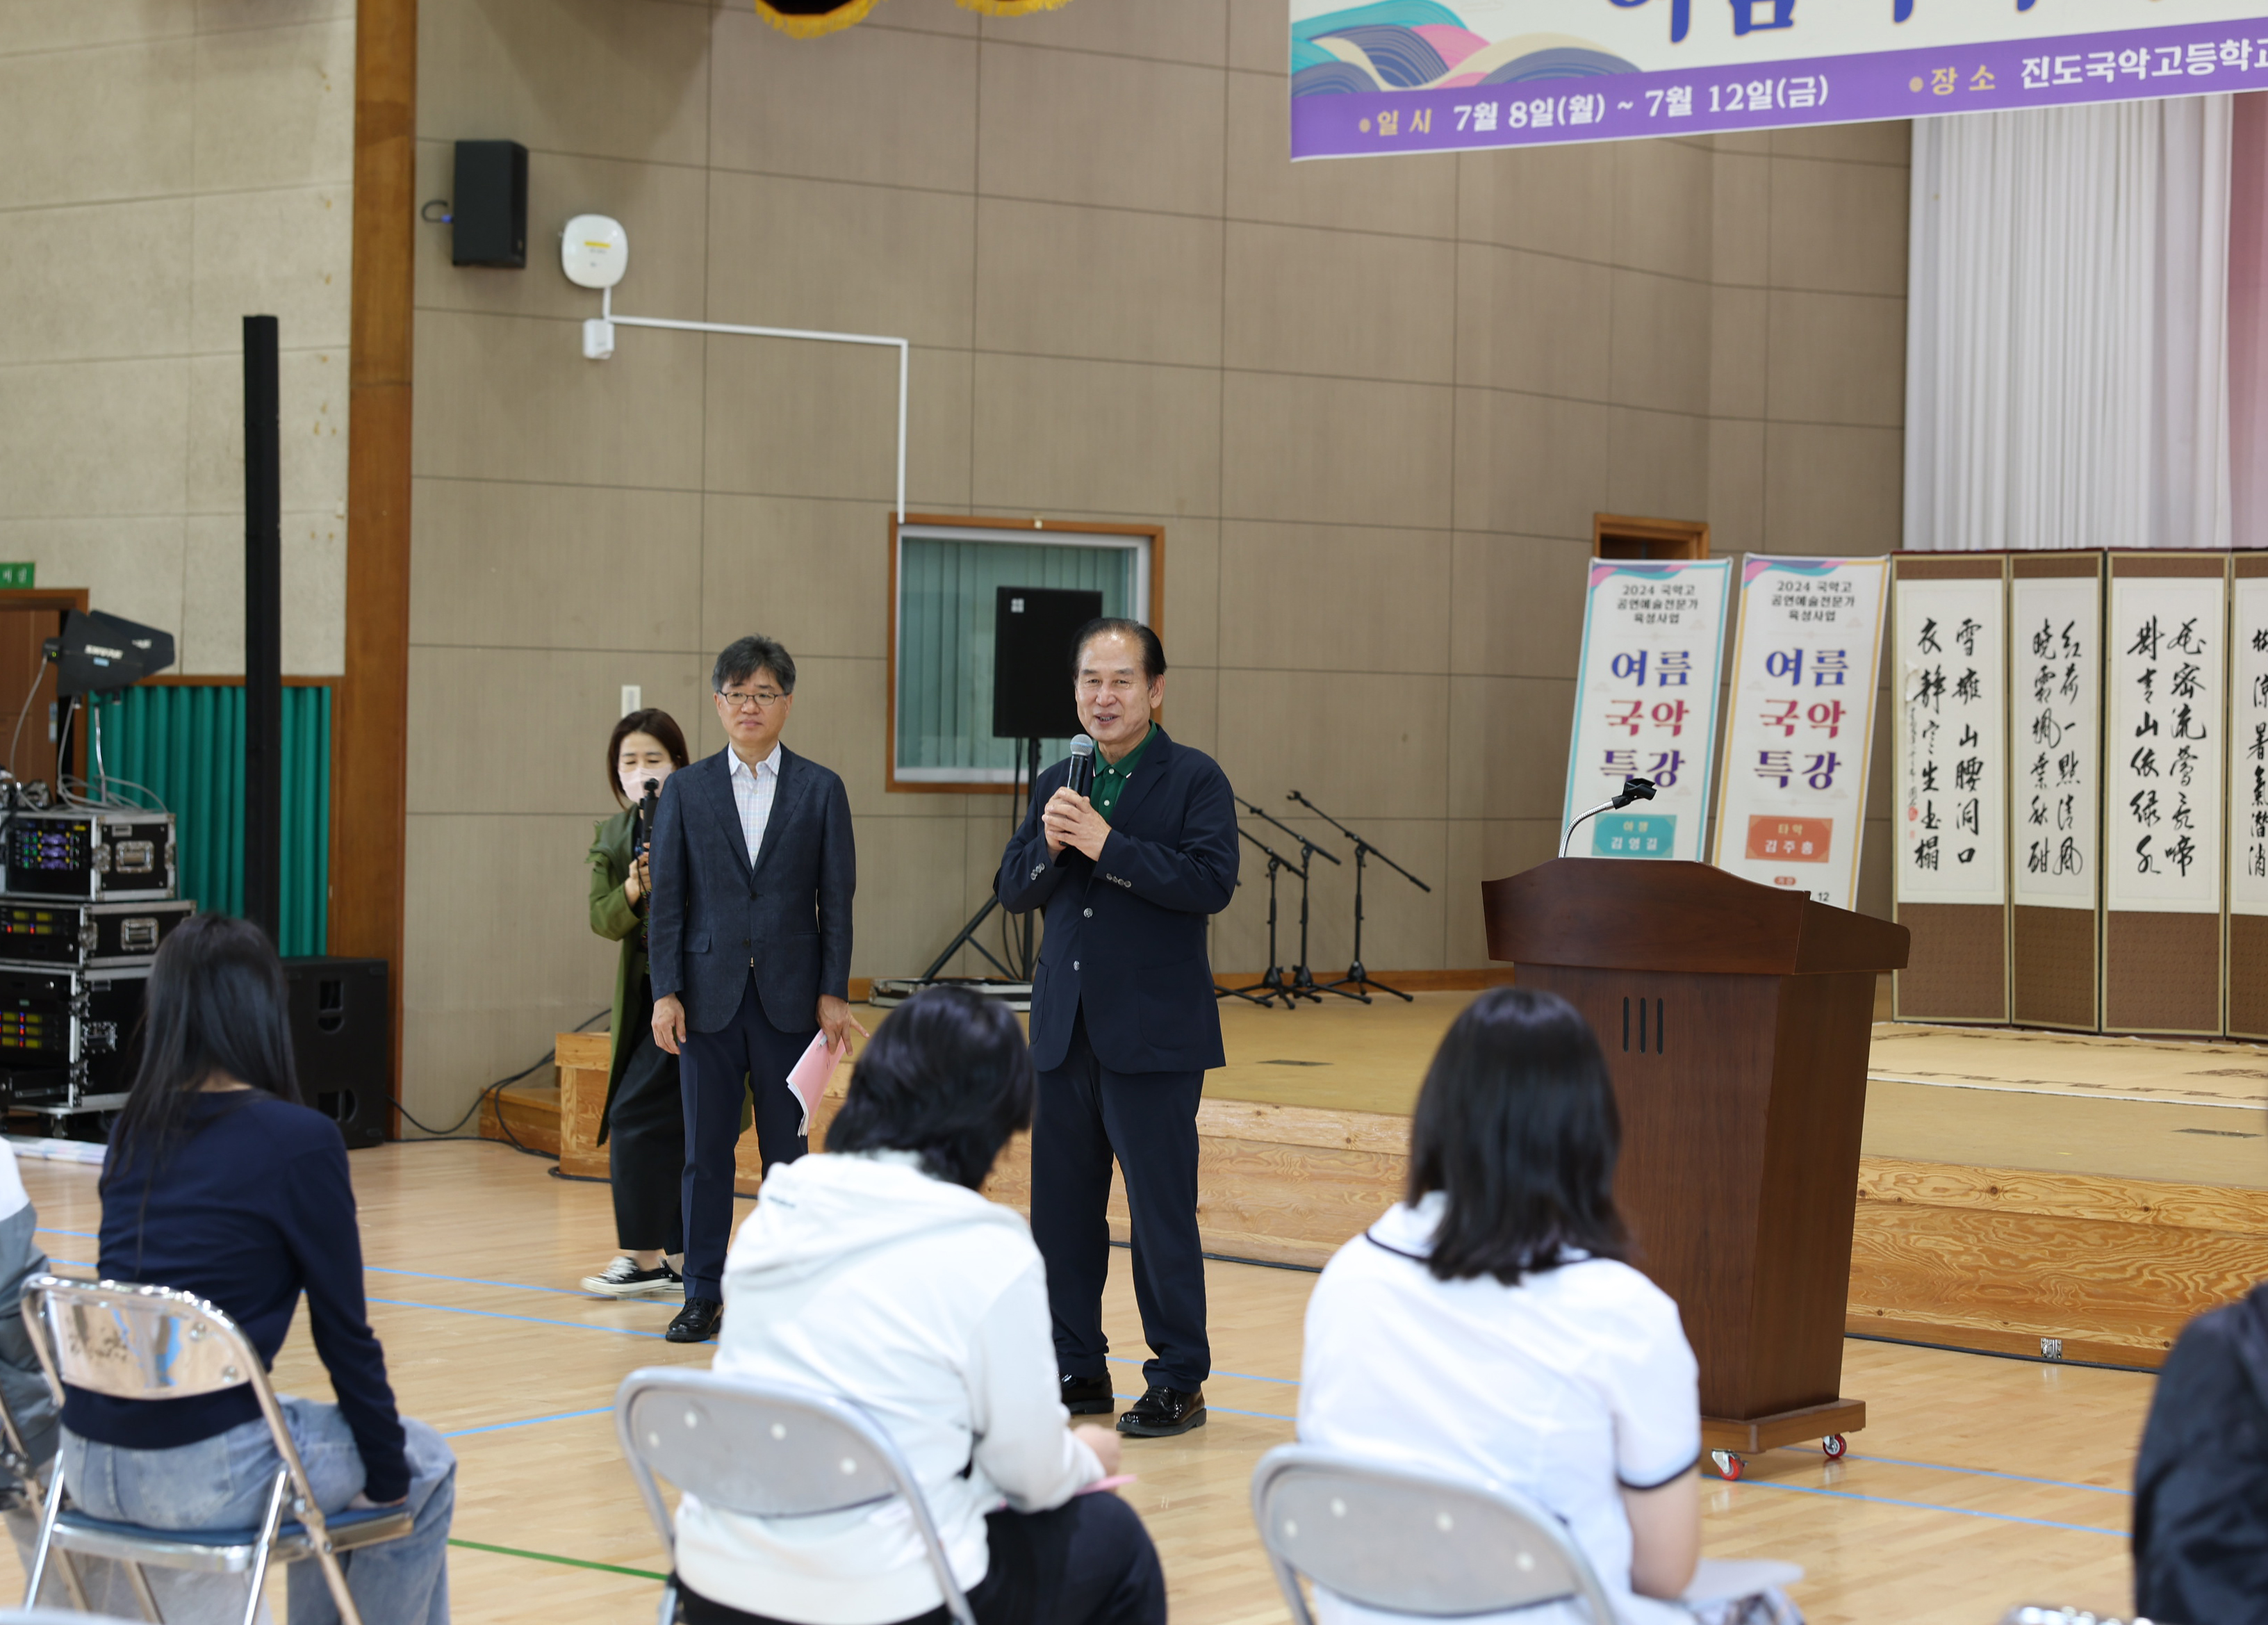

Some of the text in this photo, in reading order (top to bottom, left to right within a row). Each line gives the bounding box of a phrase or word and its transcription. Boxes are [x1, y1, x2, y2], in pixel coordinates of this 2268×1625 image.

[1454, 101, 1499, 133] 7월
[1509, 93, 1606, 129] 8일(월)
[1645, 85, 1693, 118] 7월
[1709, 74, 1829, 113] 12일(금)
[1623, 585, 1695, 596] 2024 국악고
[1777, 580, 1852, 592] 2024 국악고
[1611, 650, 1692, 687] 여름
[1766, 648, 1849, 687] 여름
[1604, 699, 1689, 737] 국악
[1759, 699, 1846, 739] 국악
[1600, 749, 1686, 787] 특강
[1754, 751, 1842, 790] 특강
[1818, 892, 1830, 901] 12
